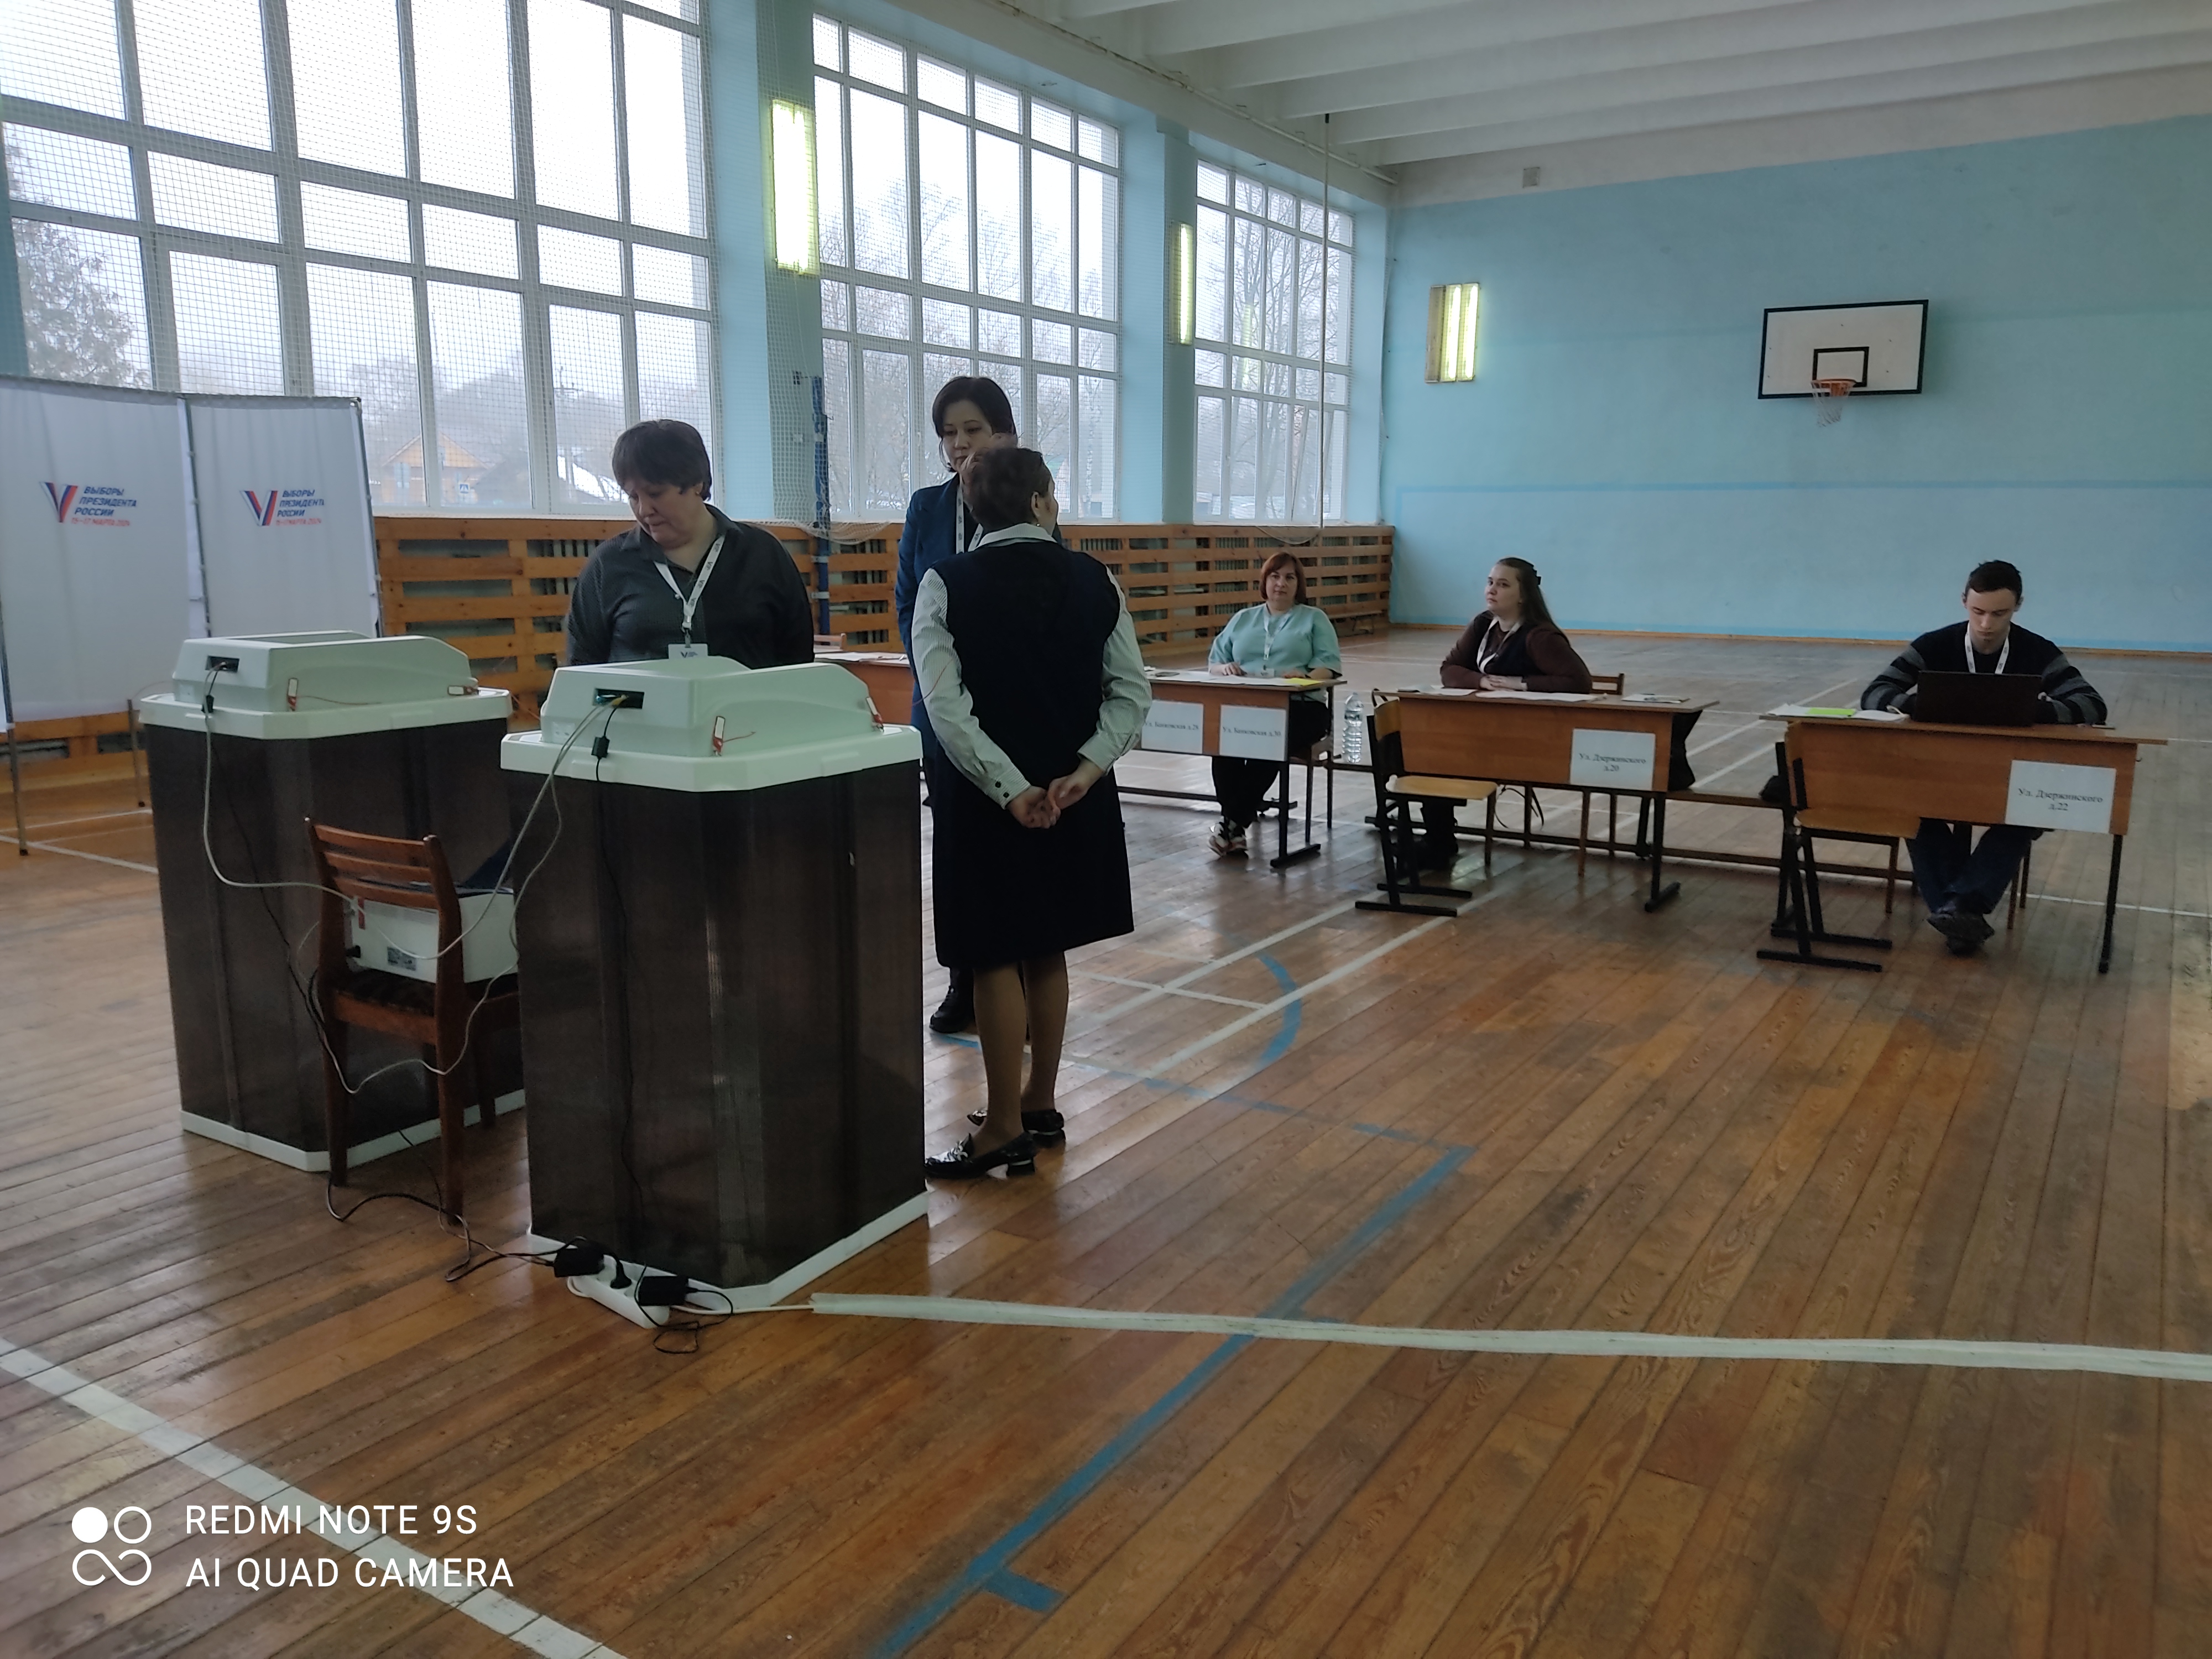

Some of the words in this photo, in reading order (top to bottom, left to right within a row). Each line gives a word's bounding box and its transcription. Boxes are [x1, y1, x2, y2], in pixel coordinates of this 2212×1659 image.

[84, 486, 124, 495] ВЫБОРЫ
[79, 497, 137, 507] ПРЕЗИДЕНТА
[75, 507, 114, 515] РОССИИ
[2018, 788, 2033, 797] Ул.
[2036, 790, 2103, 802] Дзержинского
[2048, 802, 2069, 811] д.22
